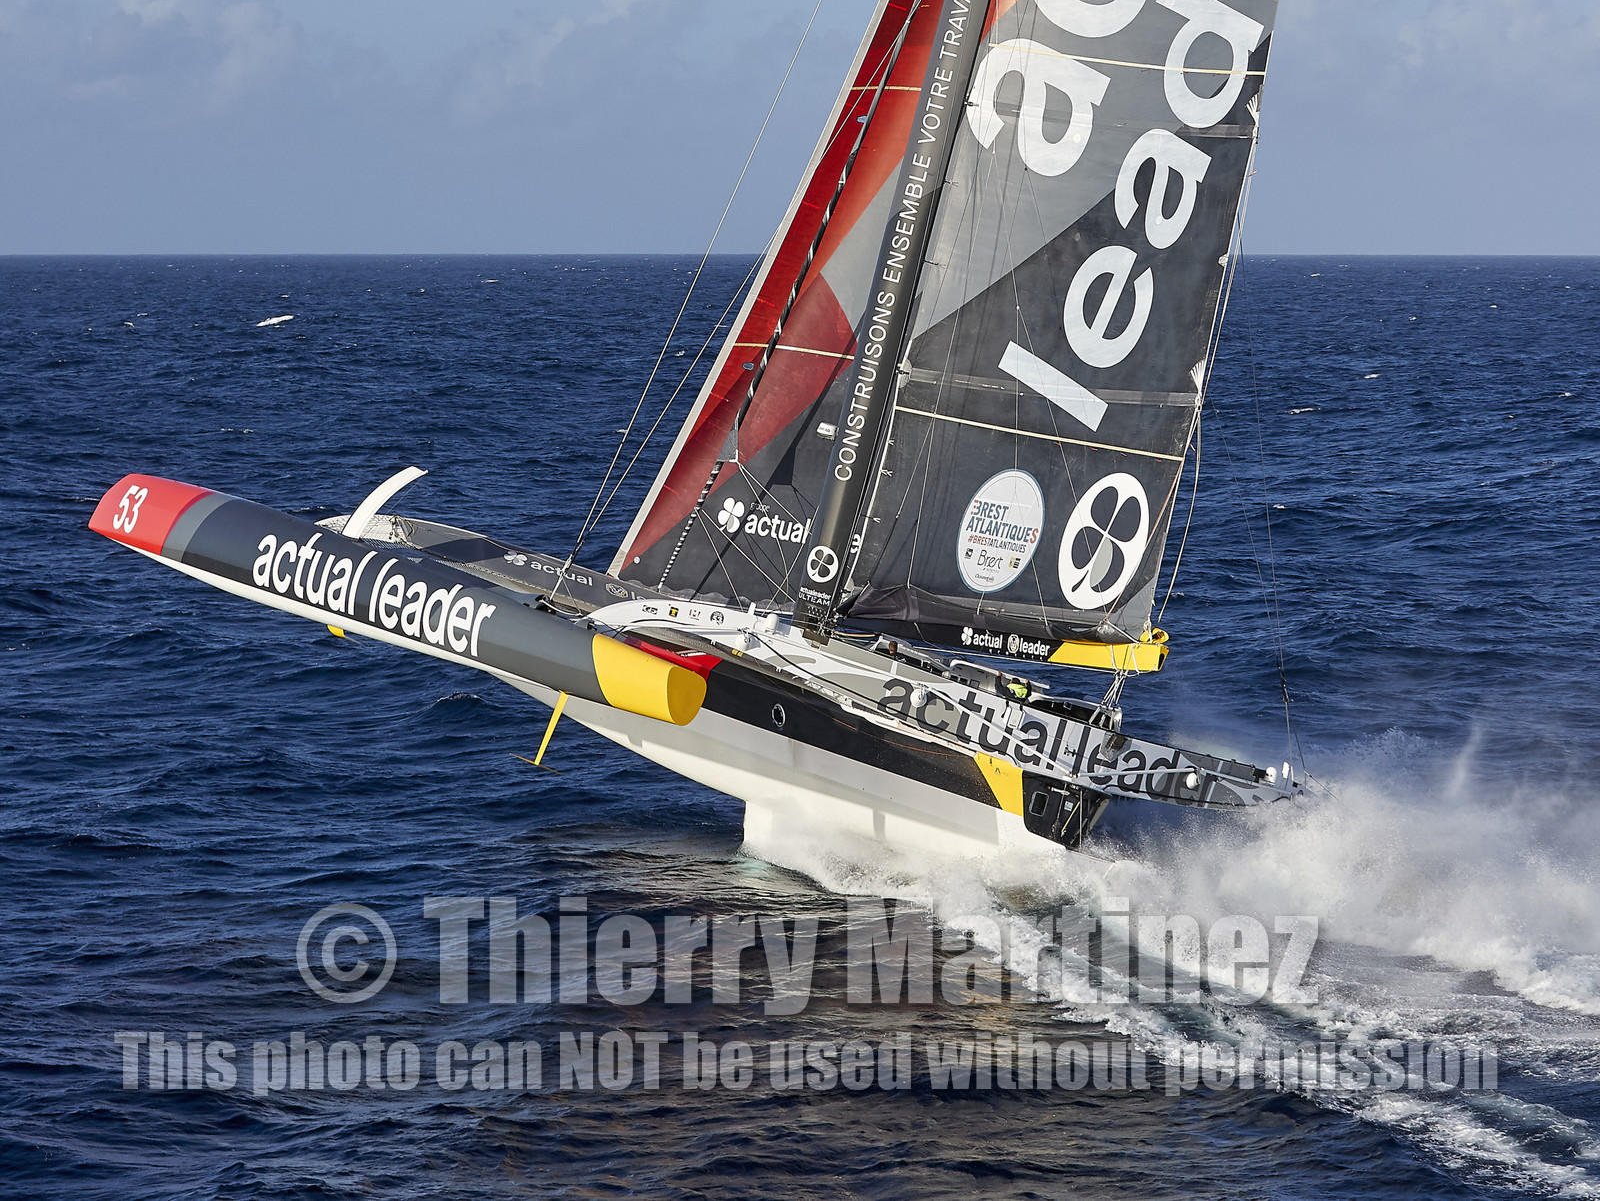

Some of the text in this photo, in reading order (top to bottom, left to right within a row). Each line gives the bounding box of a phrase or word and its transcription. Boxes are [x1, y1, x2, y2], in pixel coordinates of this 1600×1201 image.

[834, 291, 896, 481] CONSTRUISONS
[882, 153, 932, 283] ENSEMBLE
[918, 66, 954, 142] VOTRE
[112, 485, 149, 534] 53
[970, 499, 1009, 522] BREST
[744, 513, 811, 545] actual
[966, 516, 1039, 544] ATLANTIQUES
[967, 535, 1027, 554] #BRESTATLANTIQUES
[530, 560, 594, 586] actual
[252, 532, 497, 657] actual leader
[972, 631, 1051, 657] actual leader
[877, 677, 1215, 807] actual leader
